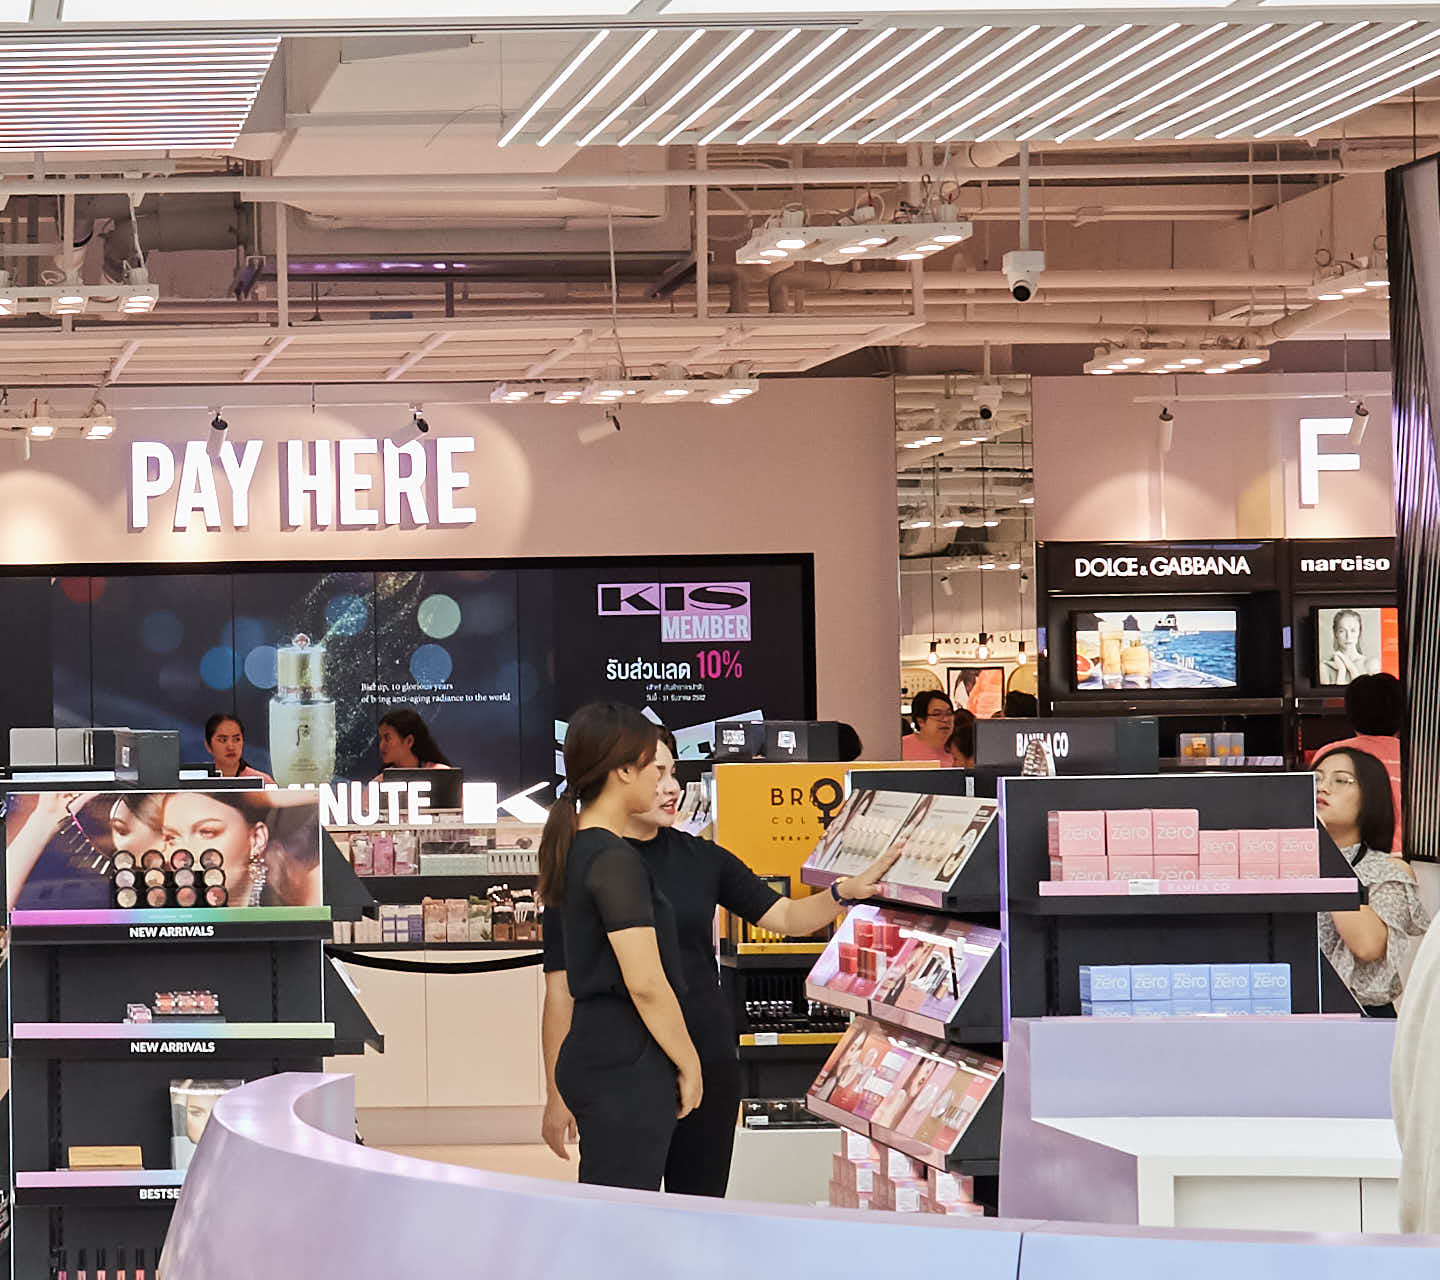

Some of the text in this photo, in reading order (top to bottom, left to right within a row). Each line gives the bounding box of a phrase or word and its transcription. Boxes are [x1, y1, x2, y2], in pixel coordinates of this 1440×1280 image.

[131, 436, 477, 529] PAY HERE
[1300, 555, 1391, 572] narciso
[600, 584, 749, 612] KIS
[661, 613, 750, 640] MEMBER
[695, 649, 744, 680] 10%
[288, 780, 433, 827] NUTE
[1156, 825, 1196, 840] zero
[129, 925, 215, 938] NEW ARRIVALS
[130, 1040, 216, 1053] NEW ARRIVALS
